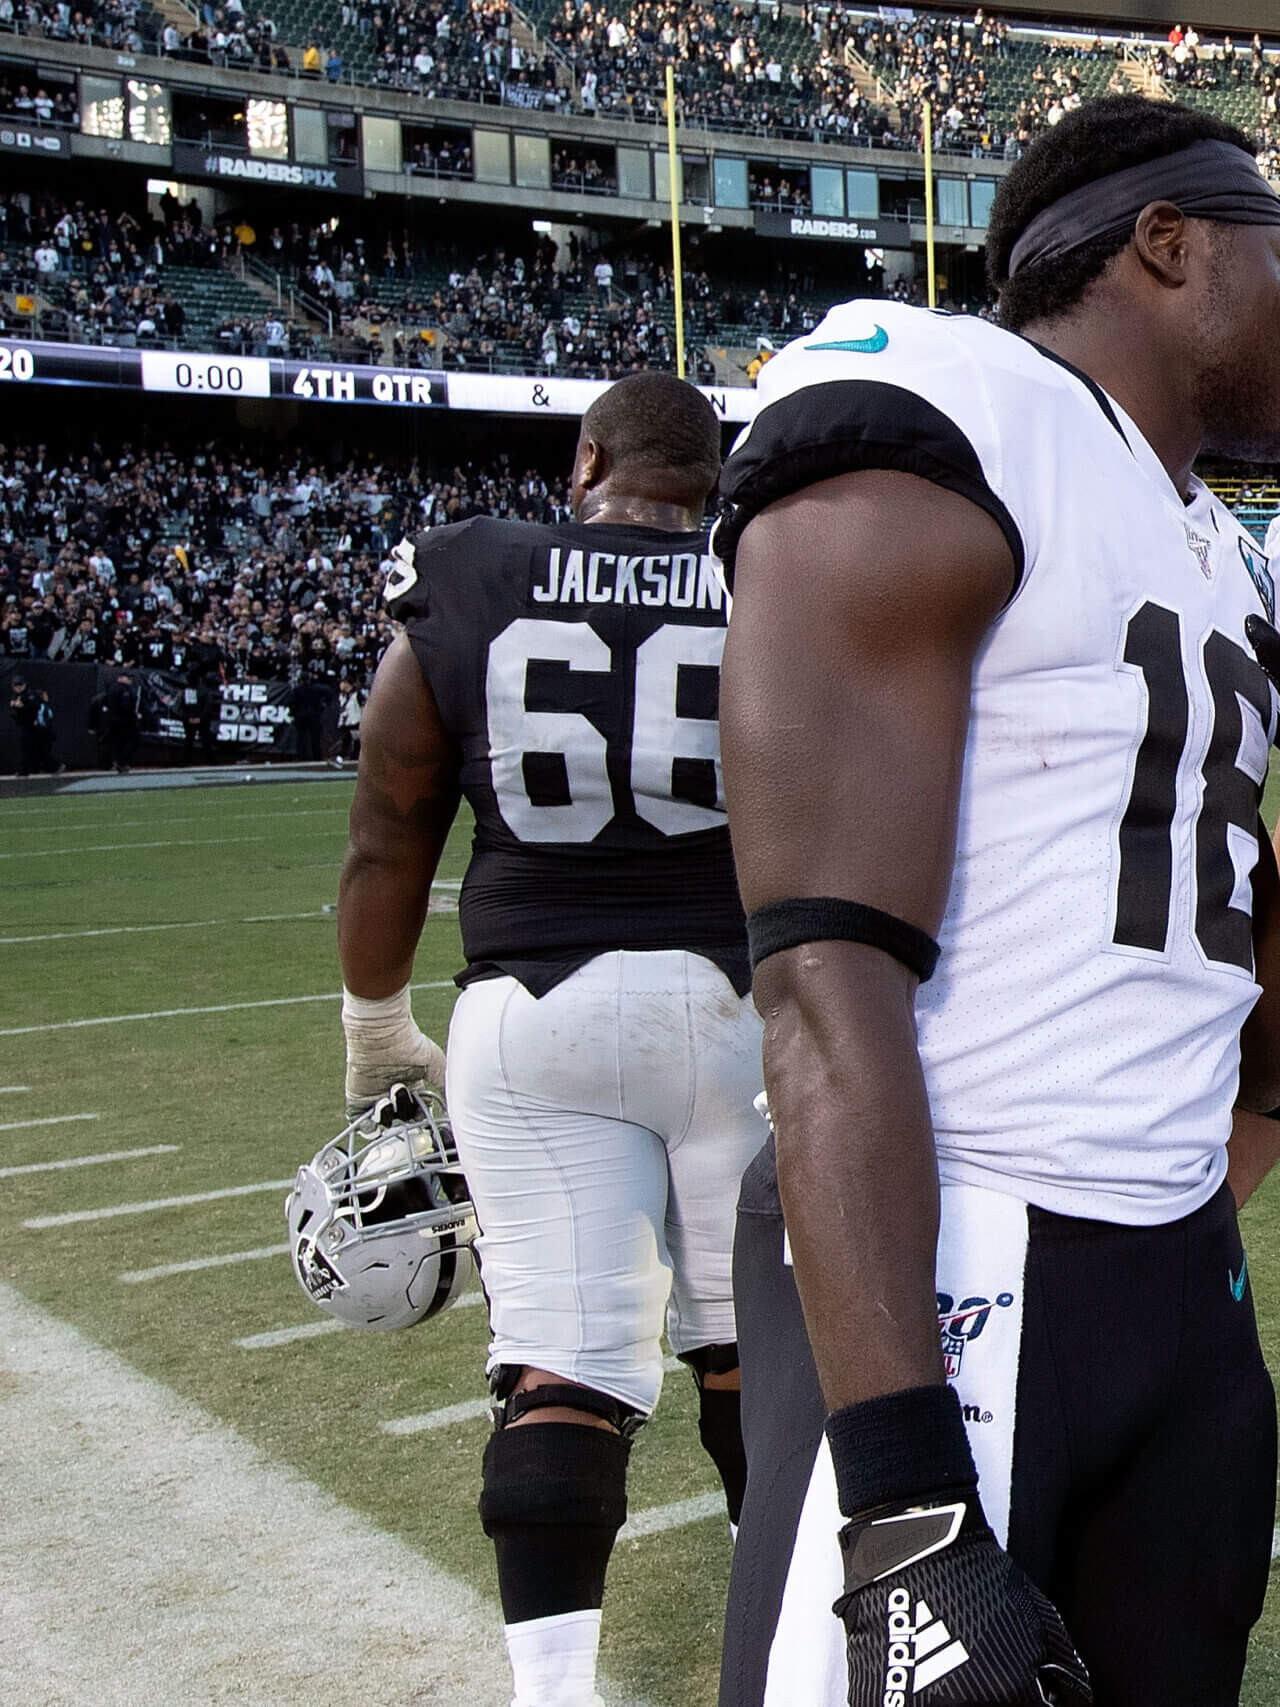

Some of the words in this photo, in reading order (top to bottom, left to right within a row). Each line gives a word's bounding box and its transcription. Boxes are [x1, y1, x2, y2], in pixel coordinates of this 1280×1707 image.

[204, 155, 337, 189] #RAIDERSPIX
[176, 362, 243, 391] 0:00
[293, 368, 356, 401] 4TH
[372, 374, 432, 404] QTR
[533, 547, 722, 611] JACKSON
[218, 683, 268, 703] THE
[216, 722, 275, 744] SIDE
[883, 1587, 918, 1707] adidas
